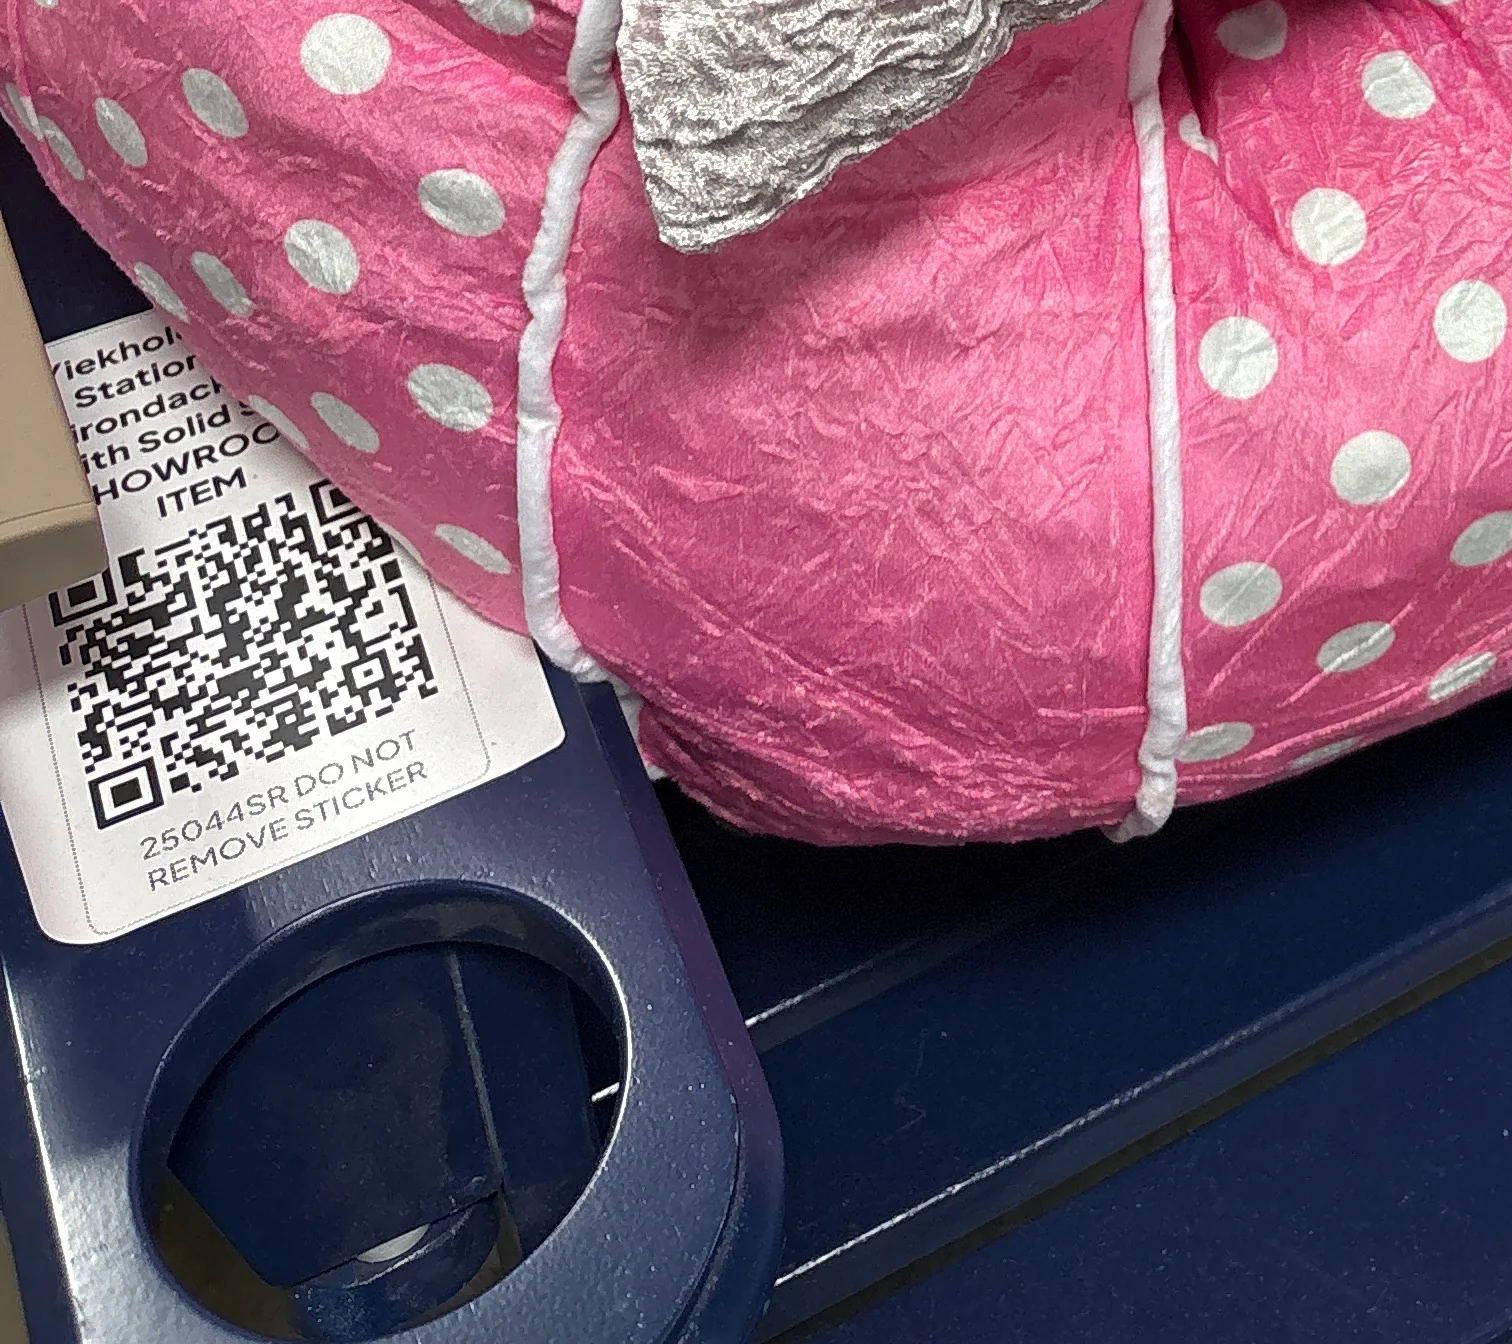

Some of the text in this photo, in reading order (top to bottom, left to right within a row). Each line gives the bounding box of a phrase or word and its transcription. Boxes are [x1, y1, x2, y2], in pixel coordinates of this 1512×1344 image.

[52, 326, 182, 380] iekhol
[80, 444, 130, 474] ith
[138, 404, 231, 453] Solid
[92, 422, 280, 505] HOWROO
[156, 467, 247, 518] ITEM
[140, 729, 415, 860] 25044SR DO NOT
[148, 762, 427, 891] REMOVE STICKER
